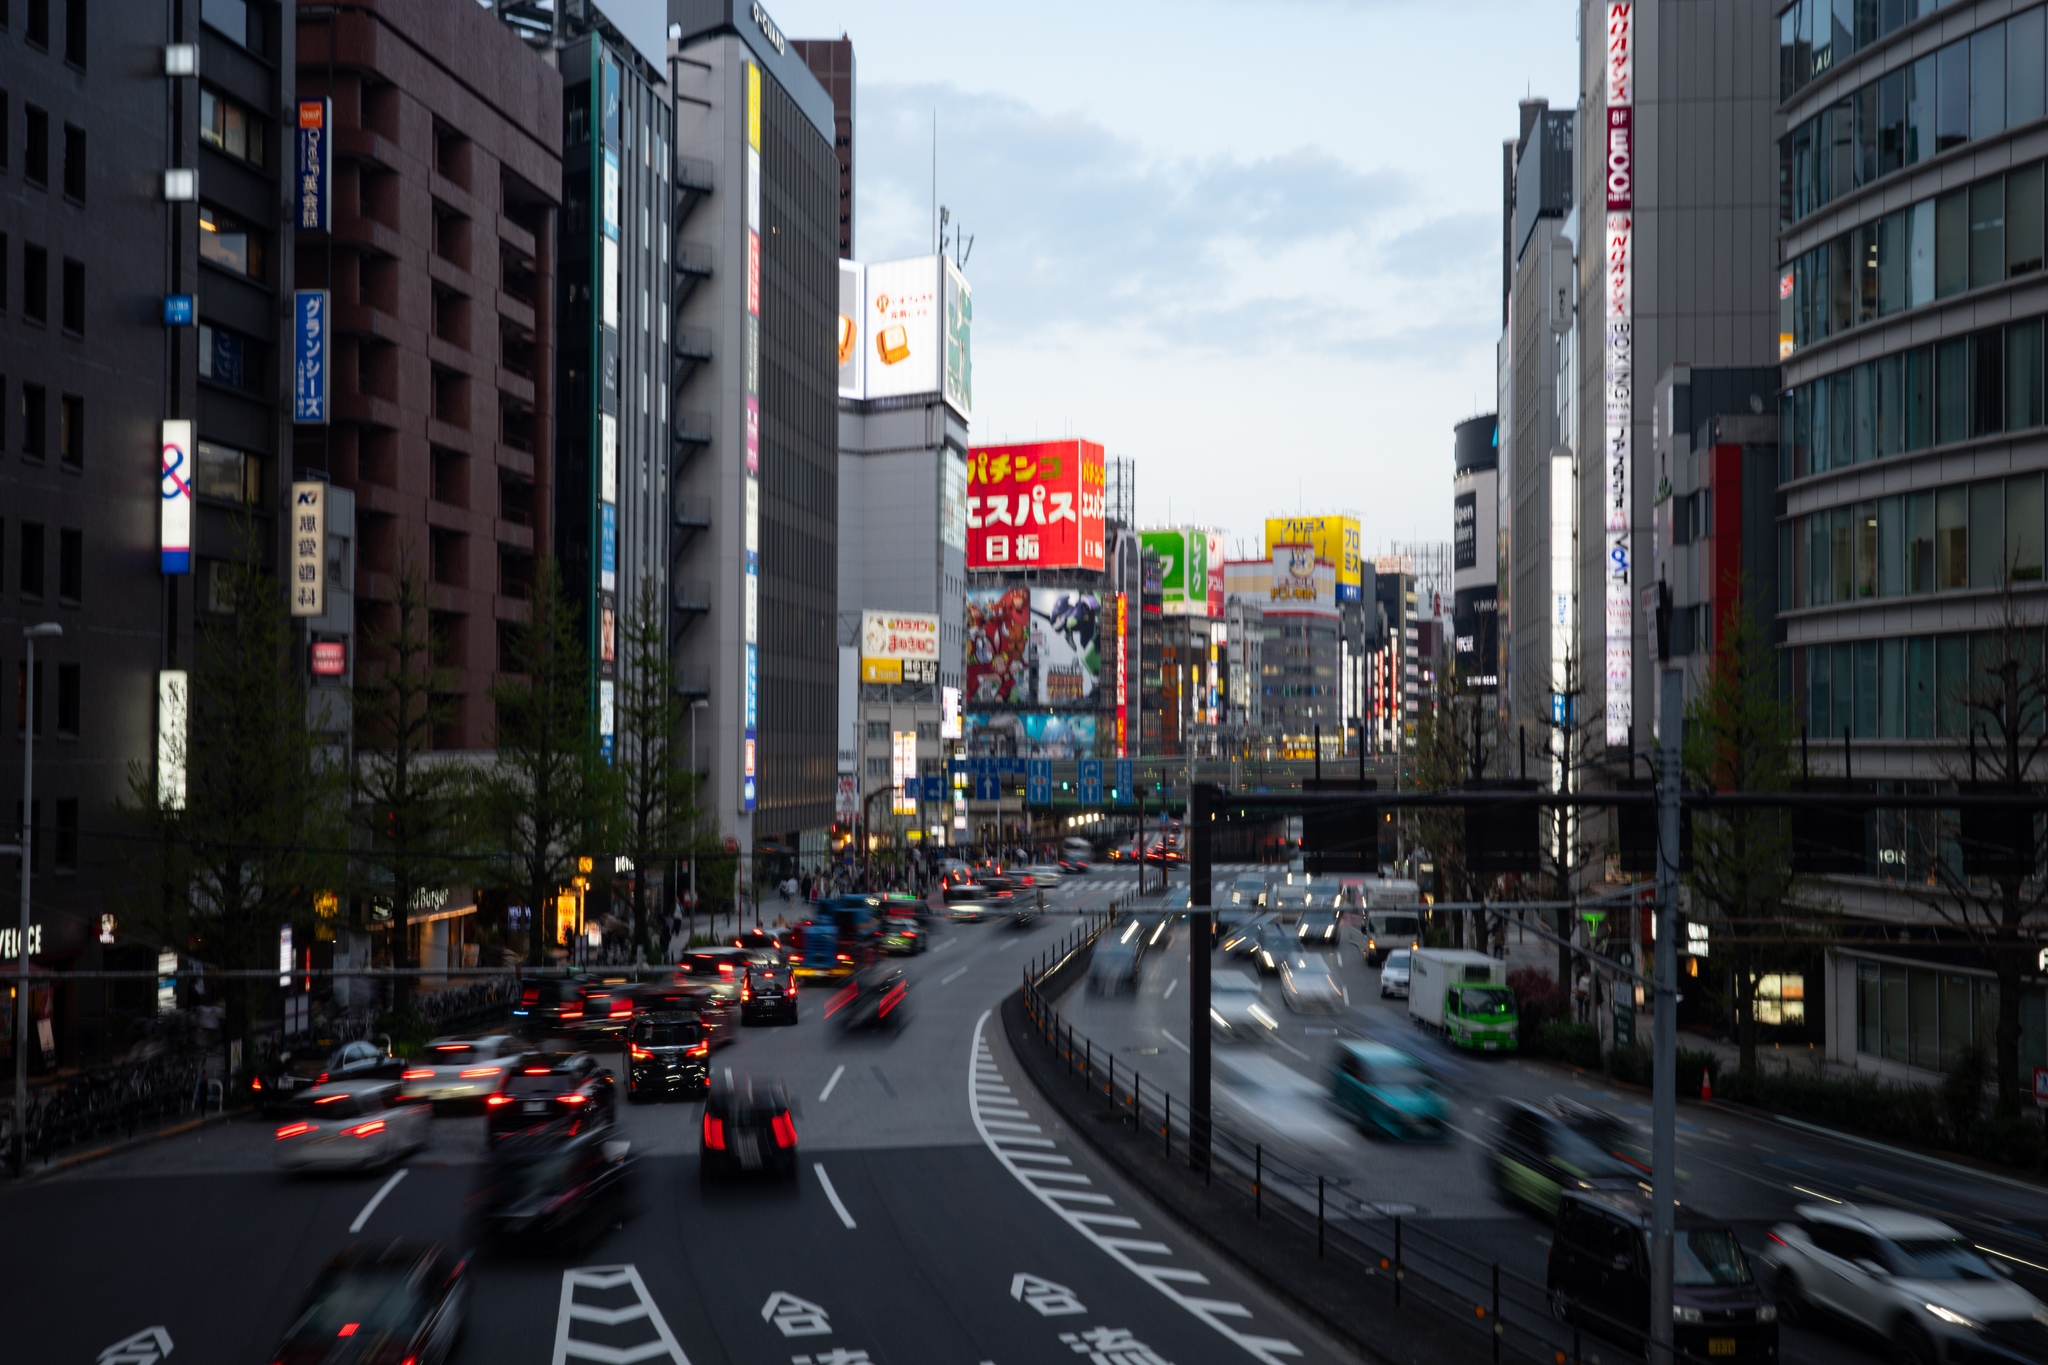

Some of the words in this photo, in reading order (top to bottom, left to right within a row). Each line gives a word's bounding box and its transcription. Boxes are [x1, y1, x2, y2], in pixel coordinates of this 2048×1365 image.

[306, 297, 322, 417] グランシーズ
[1614, 324, 1629, 400] BOXING
[968, 452, 1061, 484] パチンコ
[967, 484, 1076, 528] エスパス
[1193, 533, 1202, 593] レイク
